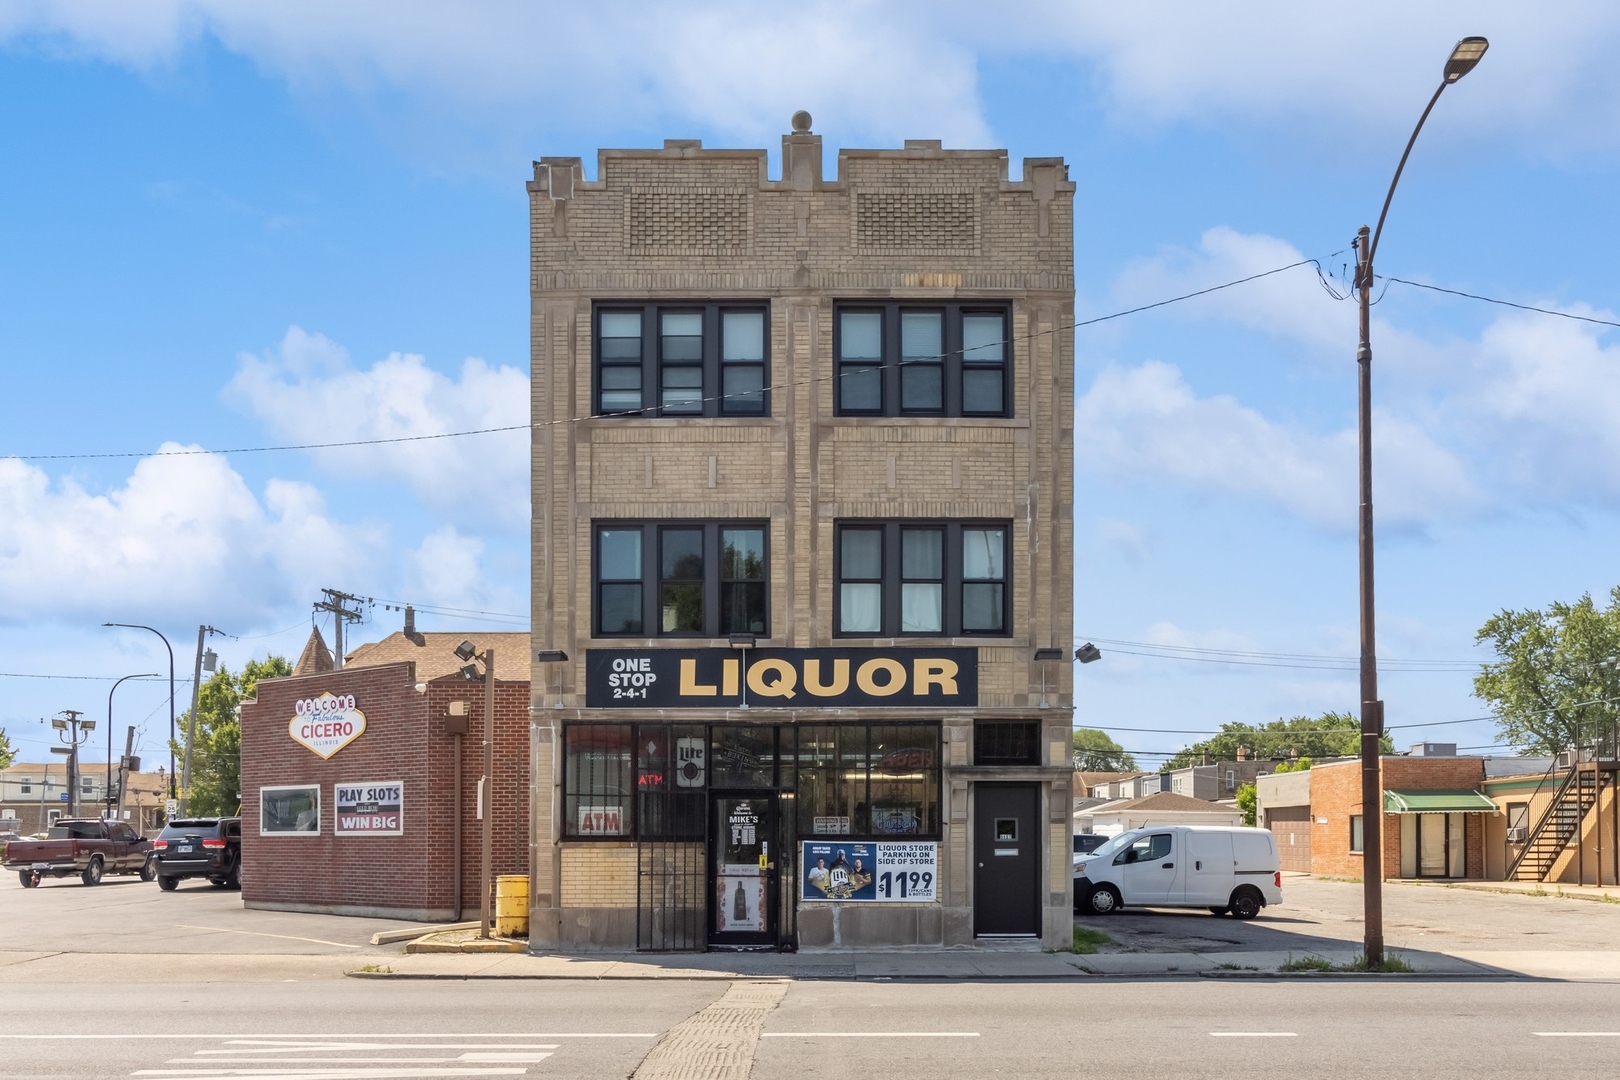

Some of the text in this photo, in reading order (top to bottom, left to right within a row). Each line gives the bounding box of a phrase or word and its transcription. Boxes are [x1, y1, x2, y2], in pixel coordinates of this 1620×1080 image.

[612, 658, 650, 672] ONE
[608, 673, 657, 687] STOP
[680, 658, 959, 699] LIQUOR
[613, 688, 647, 698] 2-4-1
[296, 698, 353, 713] WELCOME
[312, 713, 345, 723] Fabulous
[301, 722, 353, 739] CICERO
[678, 747, 703, 761] Lite
[638, 774, 663, 785] ATM
[339, 788, 400, 802] PLAY SLOTS
[341, 816, 396, 829] WIN BIG
[582, 813, 620, 831] ATM
[729, 816, 759, 824] MIKE'S
